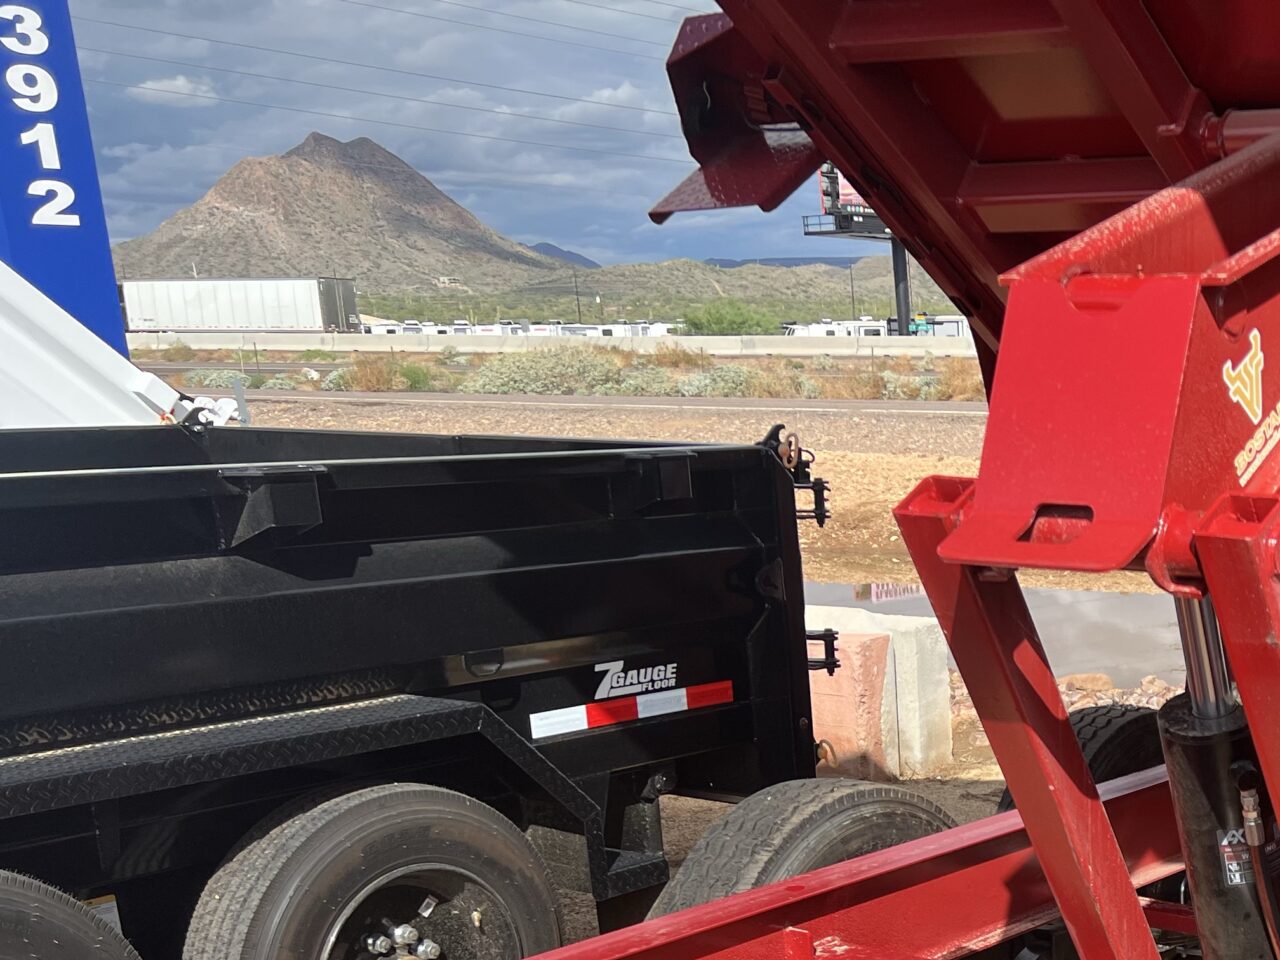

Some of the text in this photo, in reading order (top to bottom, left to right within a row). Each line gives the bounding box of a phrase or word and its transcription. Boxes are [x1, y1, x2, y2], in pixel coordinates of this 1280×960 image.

[594, 660, 678, 700] 7 GAUGE
[641, 678, 677, 692] FLOOR
